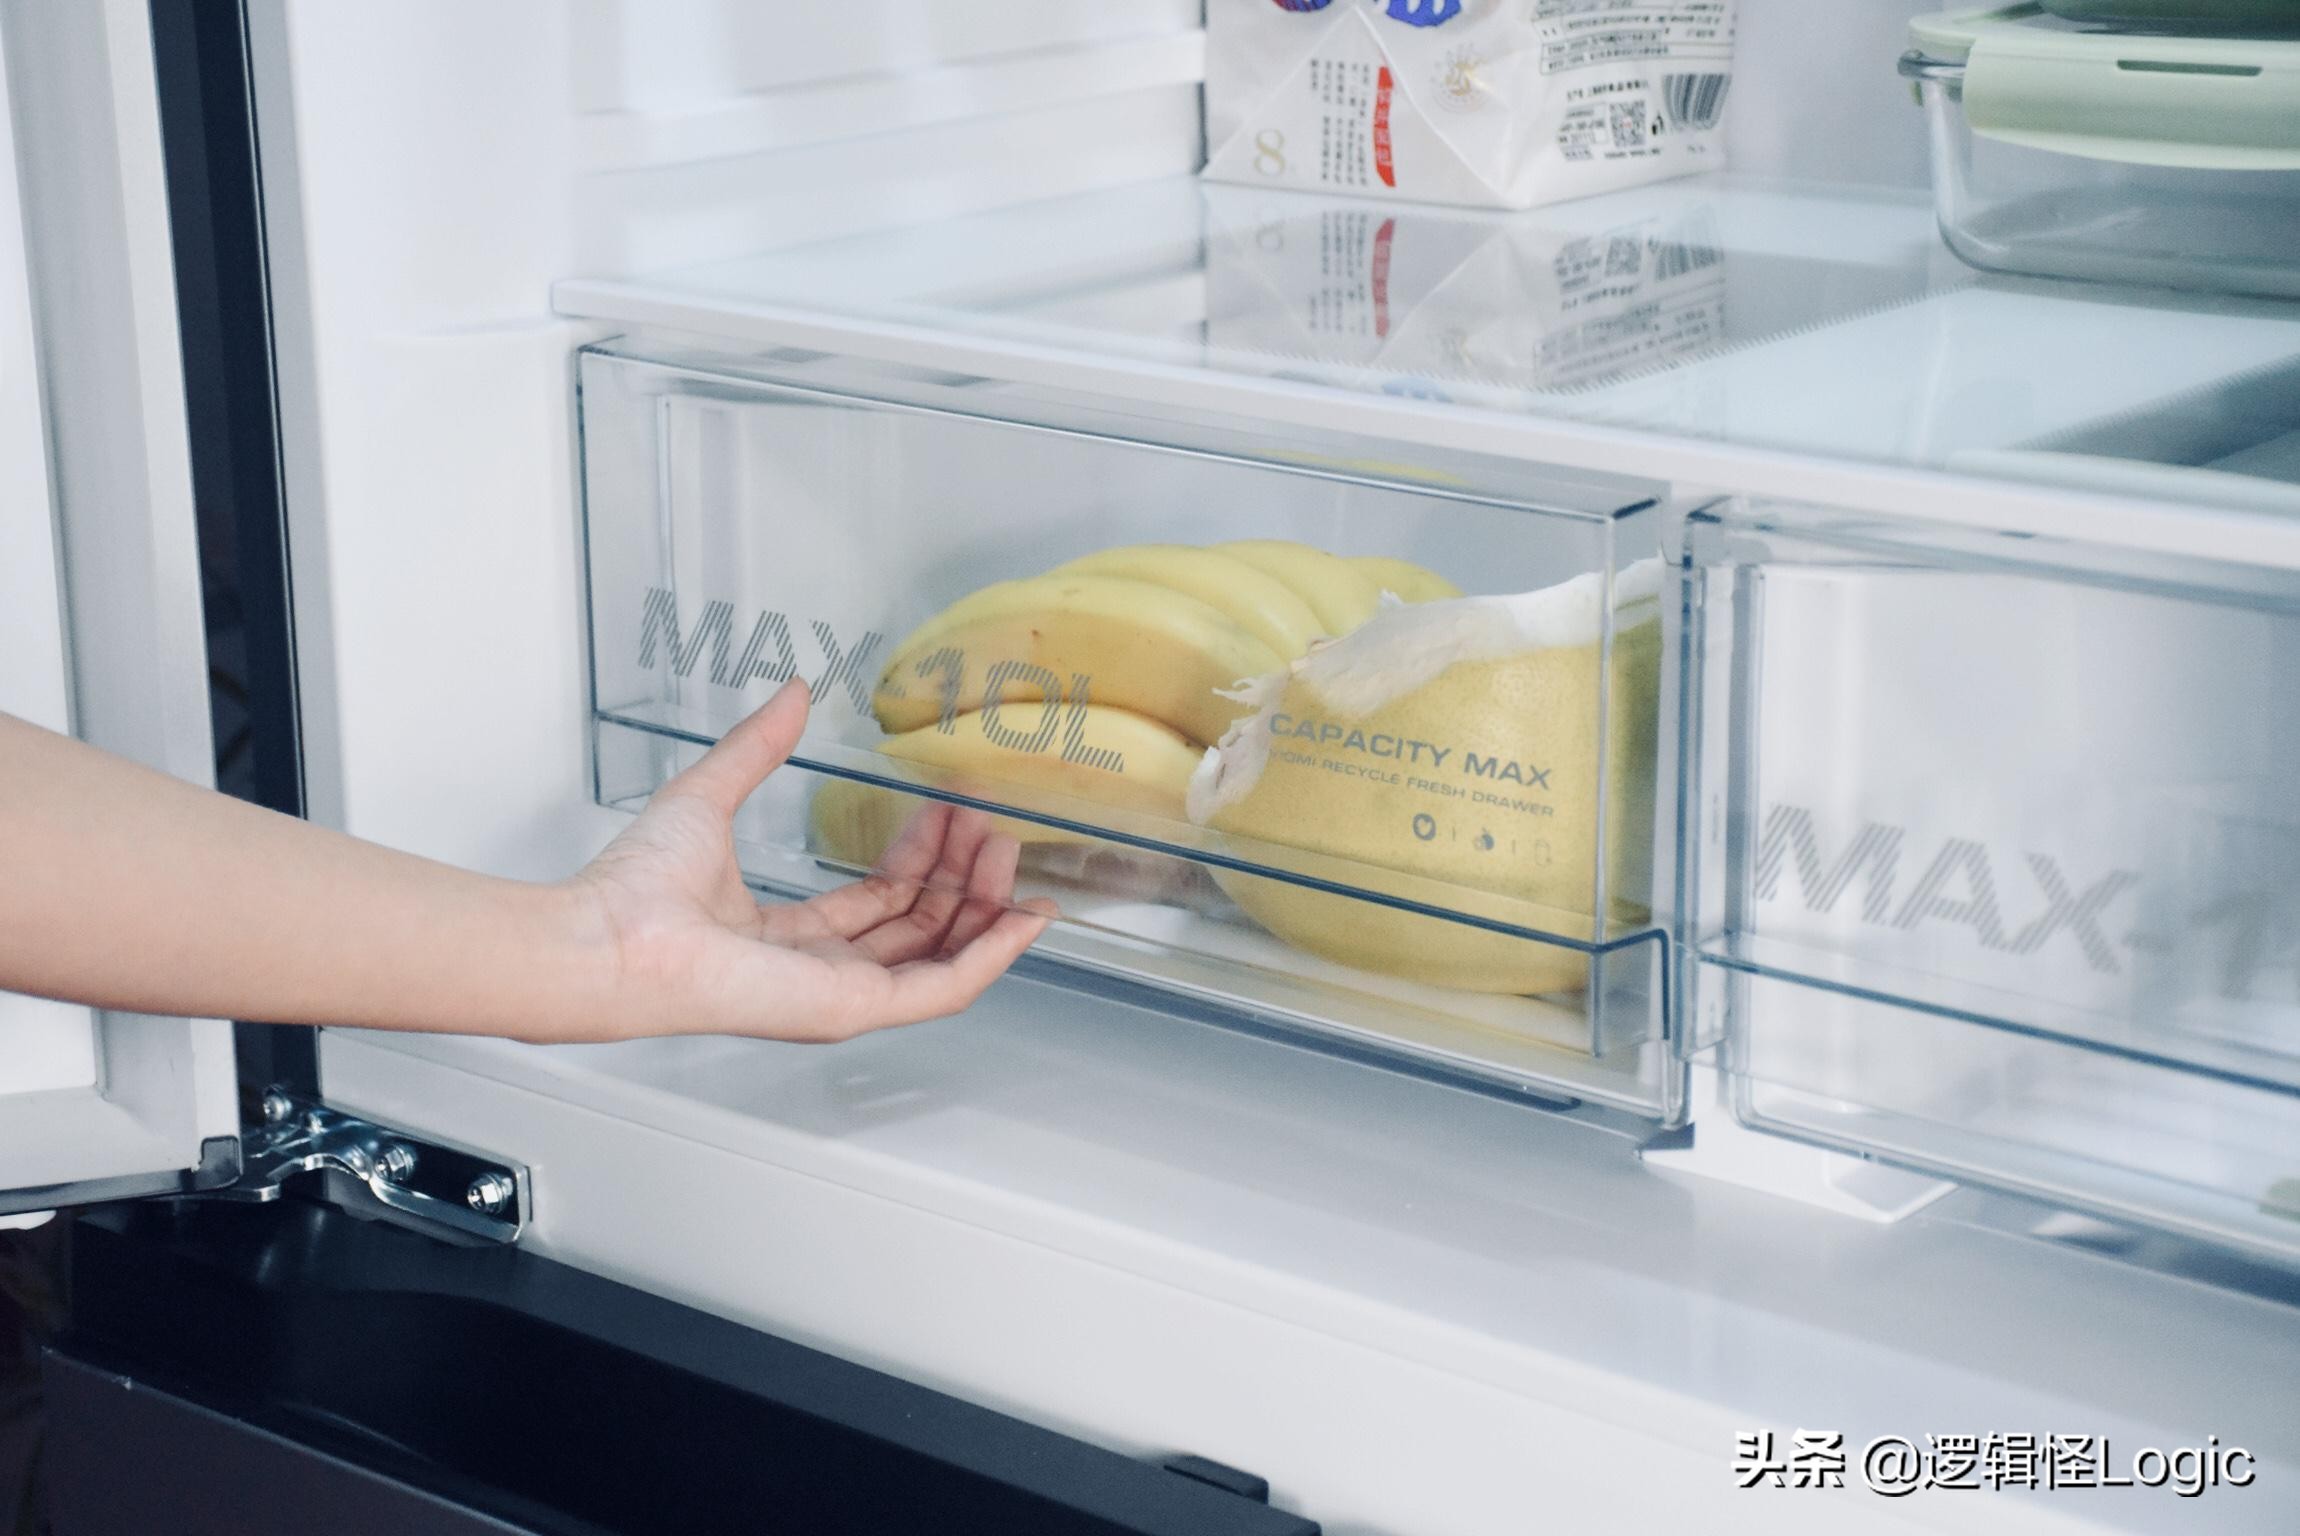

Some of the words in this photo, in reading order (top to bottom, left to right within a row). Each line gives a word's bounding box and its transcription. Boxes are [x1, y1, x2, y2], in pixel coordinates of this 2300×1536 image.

[1268, 713, 1452, 768] CAPACITY
[1463, 752, 1552, 791] MAX
[1321, 759, 1401, 785] RECYCLE
[1406, 776, 1466, 799] FRESH
[1471, 790, 1555, 818] DRAWER
